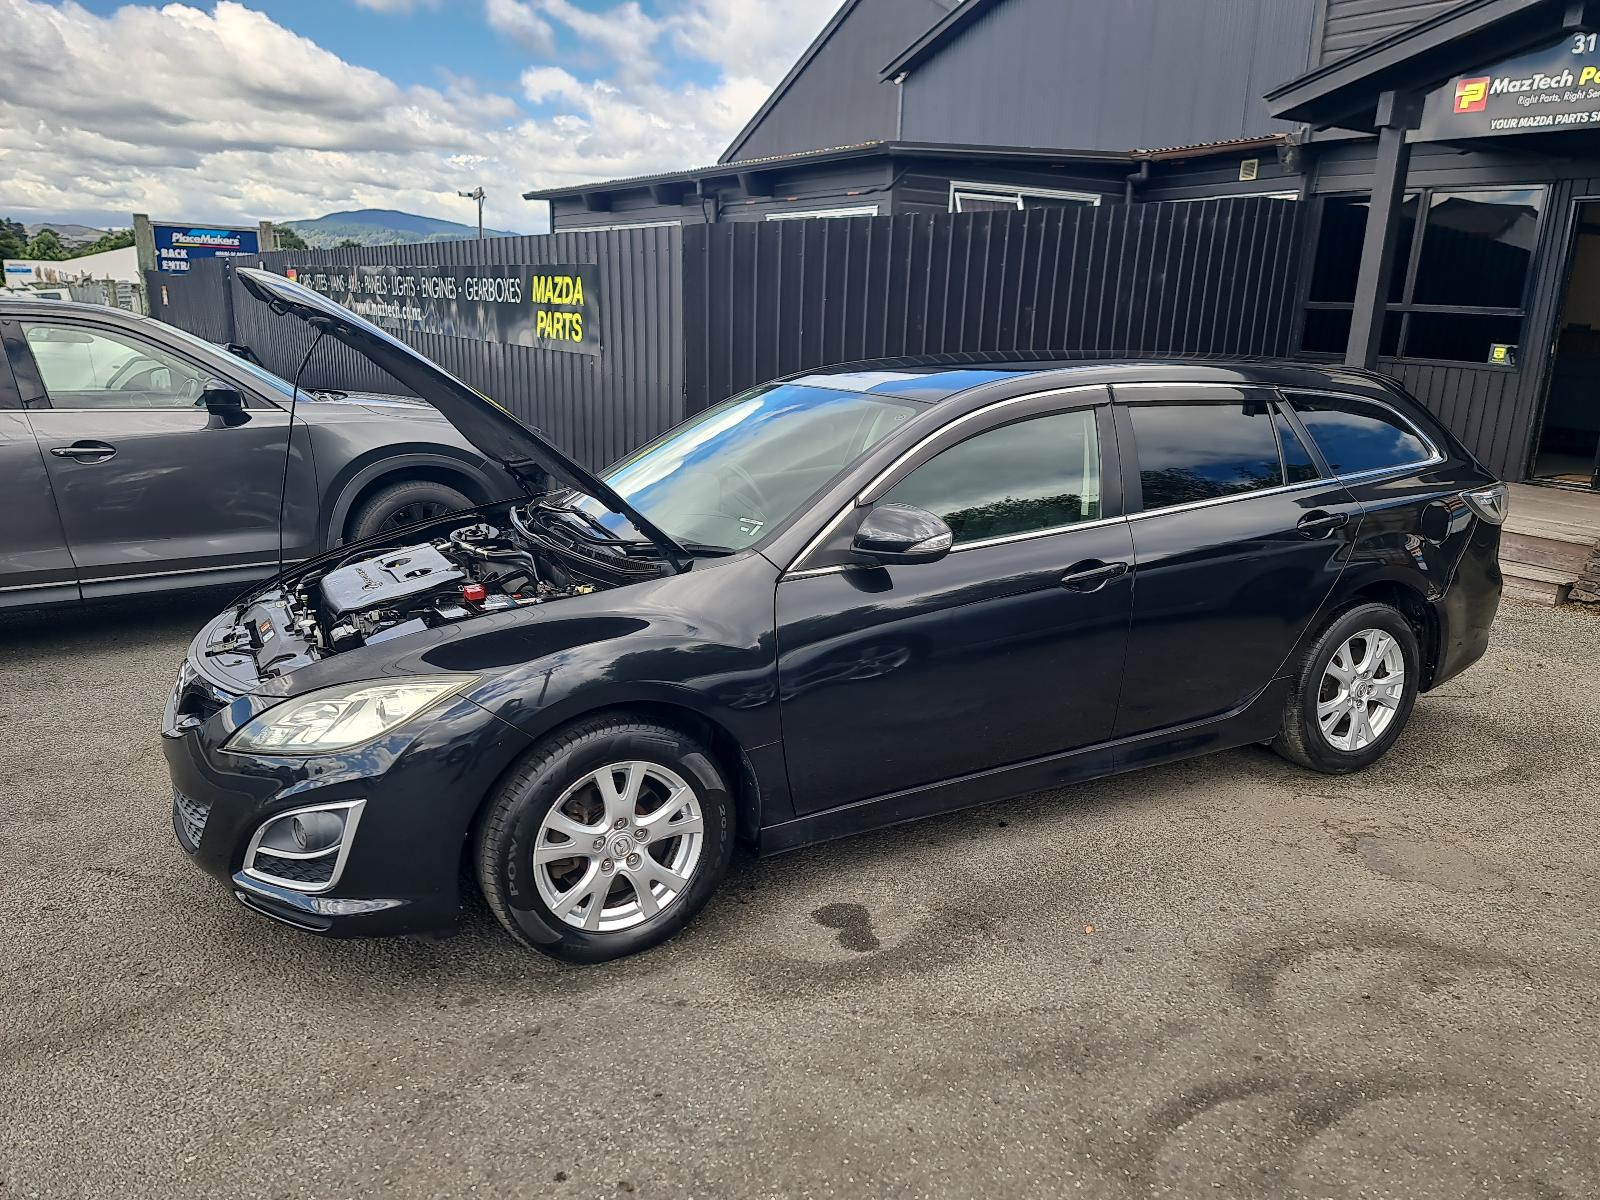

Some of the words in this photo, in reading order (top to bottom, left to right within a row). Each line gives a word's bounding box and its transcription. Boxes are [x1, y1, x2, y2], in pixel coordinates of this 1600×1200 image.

[1571, 33, 1598, 54] 31
[1489, 69, 1574, 95] MazTech
[1517, 94, 1539, 107] Right
[1563, 89, 1586, 103] Right
[1490, 118, 1518, 130] YOUR
[1518, 115, 1553, 128] MAZDA
[1554, 111, 1589, 125] PARTS
[171, 231, 240, 247] PlaceMakers
[160, 248, 189, 259] BACK
[364, 275, 388, 295] PANELS
[391, 275, 416, 297] LIGHTS
[422, 276, 457, 300] ENGINES
[465, 276, 522, 304] GEARBOXES
[531, 275, 585, 307] MAZDA
[536, 310, 583, 343] PARTS
